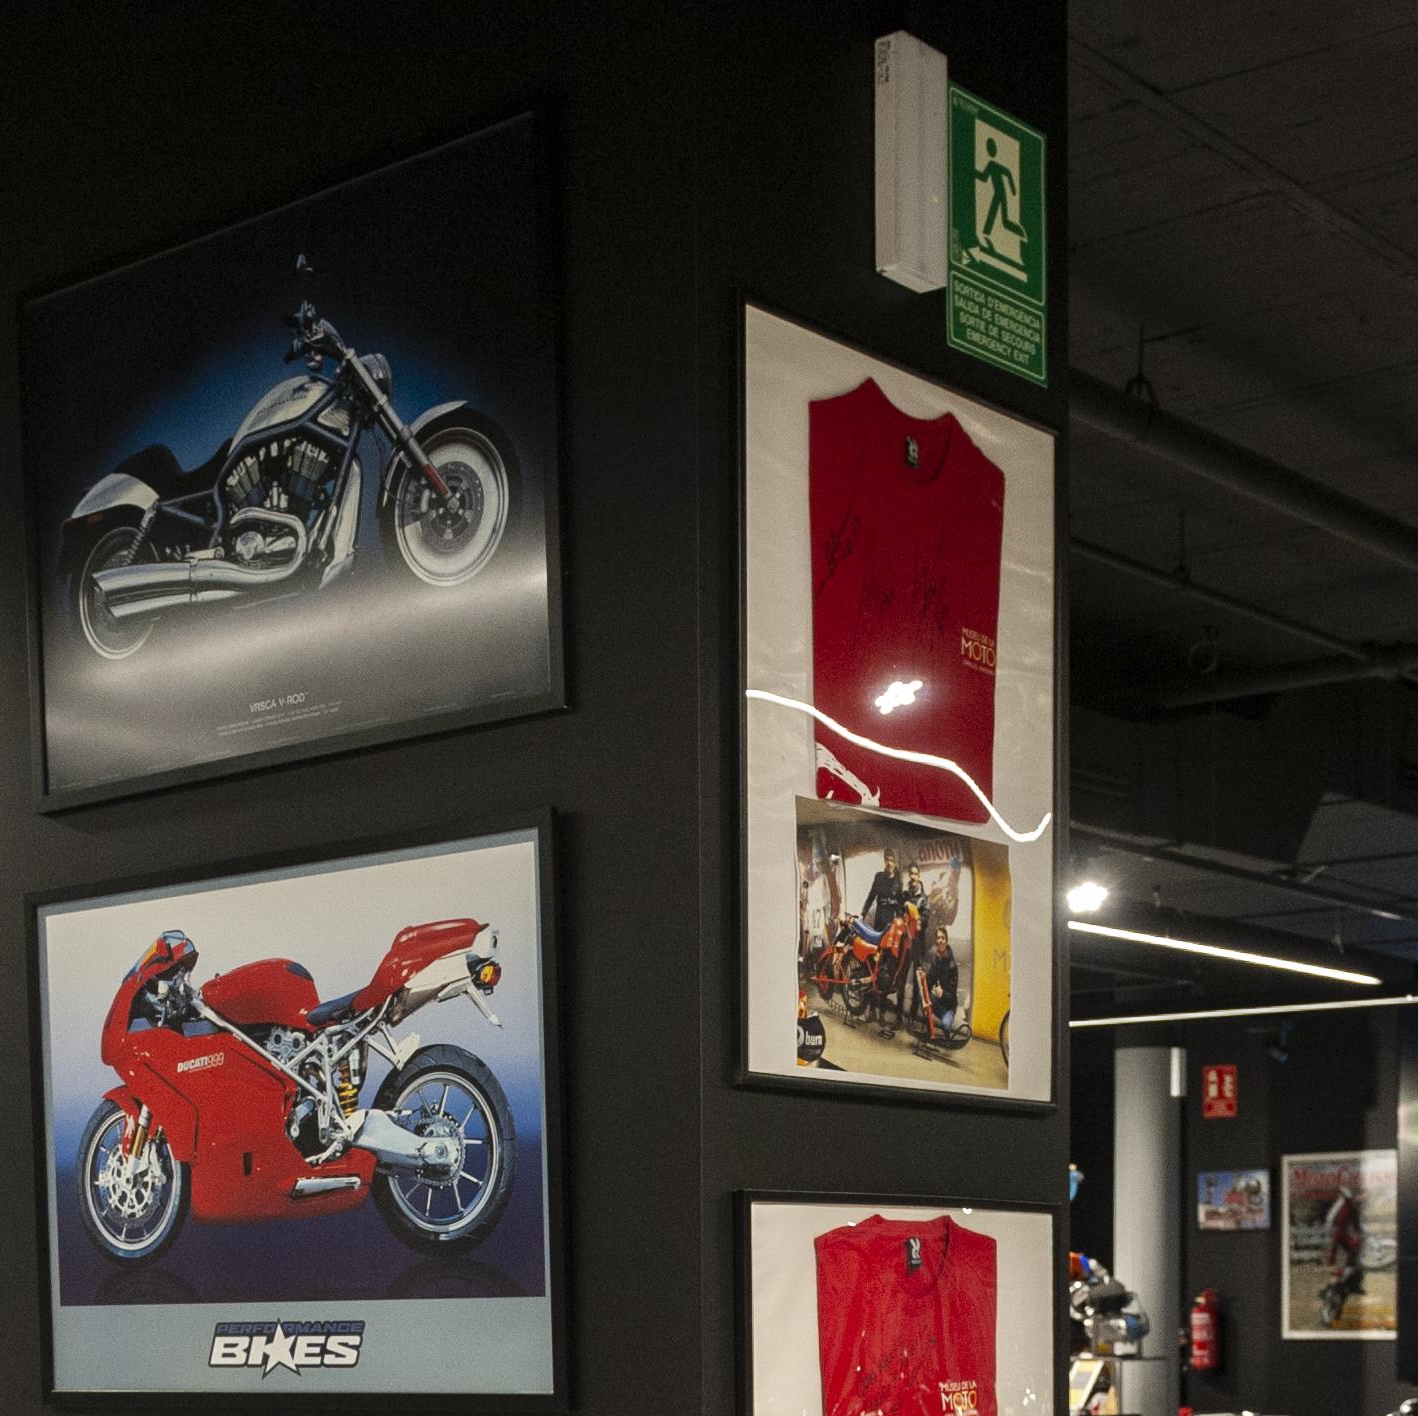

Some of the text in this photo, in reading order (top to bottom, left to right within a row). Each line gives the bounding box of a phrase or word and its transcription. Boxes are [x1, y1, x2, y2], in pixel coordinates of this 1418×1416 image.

[982, 308, 992, 321] DE
[989, 324, 999, 338] DE
[966, 328, 1029, 365] EMERGENCY EXIT
[961, 636, 997, 666] MOTO
[249, 699, 277, 713] VRSCA
[177, 1055, 208, 1073] DUCATI
[216, 1321, 365, 1334] PERFORMANCE
[941, 1390, 978, 1411] MOTO
